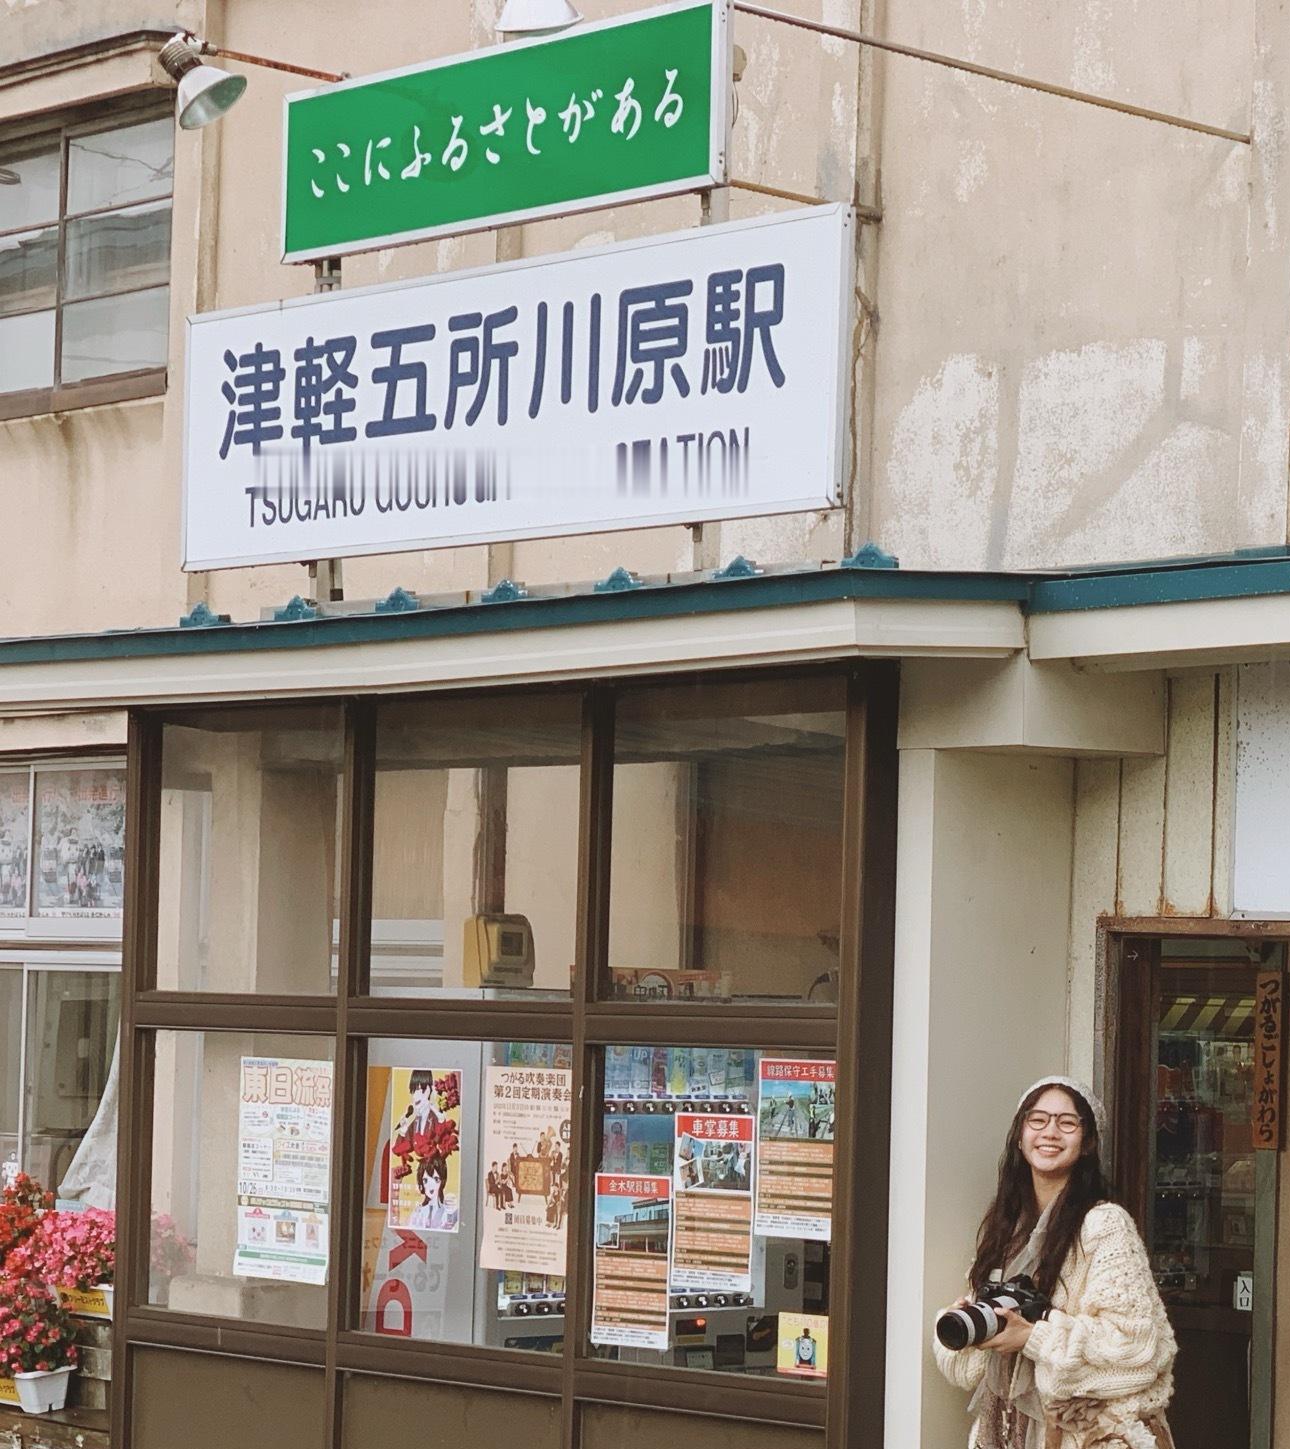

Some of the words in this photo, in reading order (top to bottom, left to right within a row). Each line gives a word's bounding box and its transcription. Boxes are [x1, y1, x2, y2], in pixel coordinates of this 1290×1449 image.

[309, 68, 686, 198] ここにふるさとがある
[218, 263, 786, 461] 津軽五所川原駅
[1258, 978, 1280, 1142] つがるごしょがわら
[501, 1072, 566, 1087] つがる吹奏楽団
[691, 1119, 739, 1137] 車掌募集
[608, 1180, 659, 1194] 金木駅員募集
[1240, 1279, 1251, 1307] 入口
